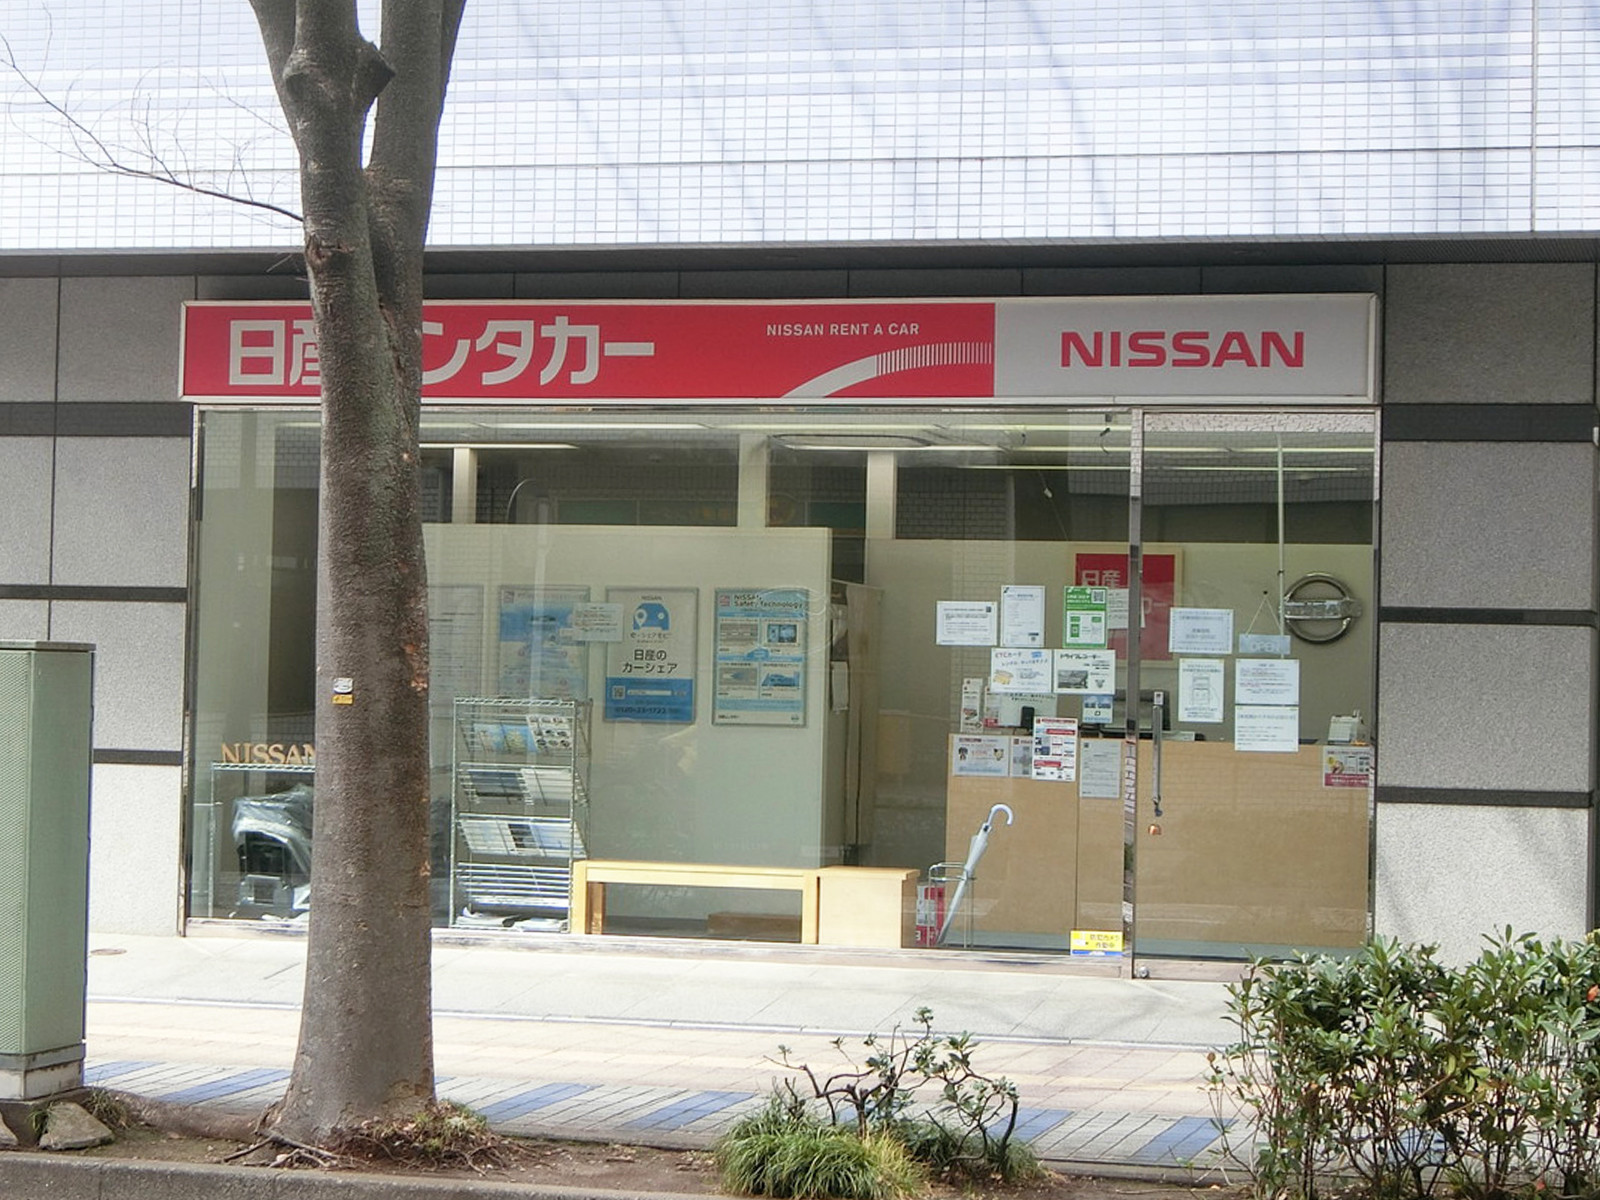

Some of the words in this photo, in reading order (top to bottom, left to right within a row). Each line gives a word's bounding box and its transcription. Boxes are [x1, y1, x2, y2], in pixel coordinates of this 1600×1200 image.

[766, 324, 824, 336] NISSAN
[829, 323, 870, 335] RENT
[873, 323, 883, 335] A
[888, 323, 920, 335] CAR
[1061, 331, 1304, 367] NISSAN
[634, 649, 667, 661] 日産の
[622, 662, 677, 674] カーシェア
[221, 743, 316, 764] NISSAN
